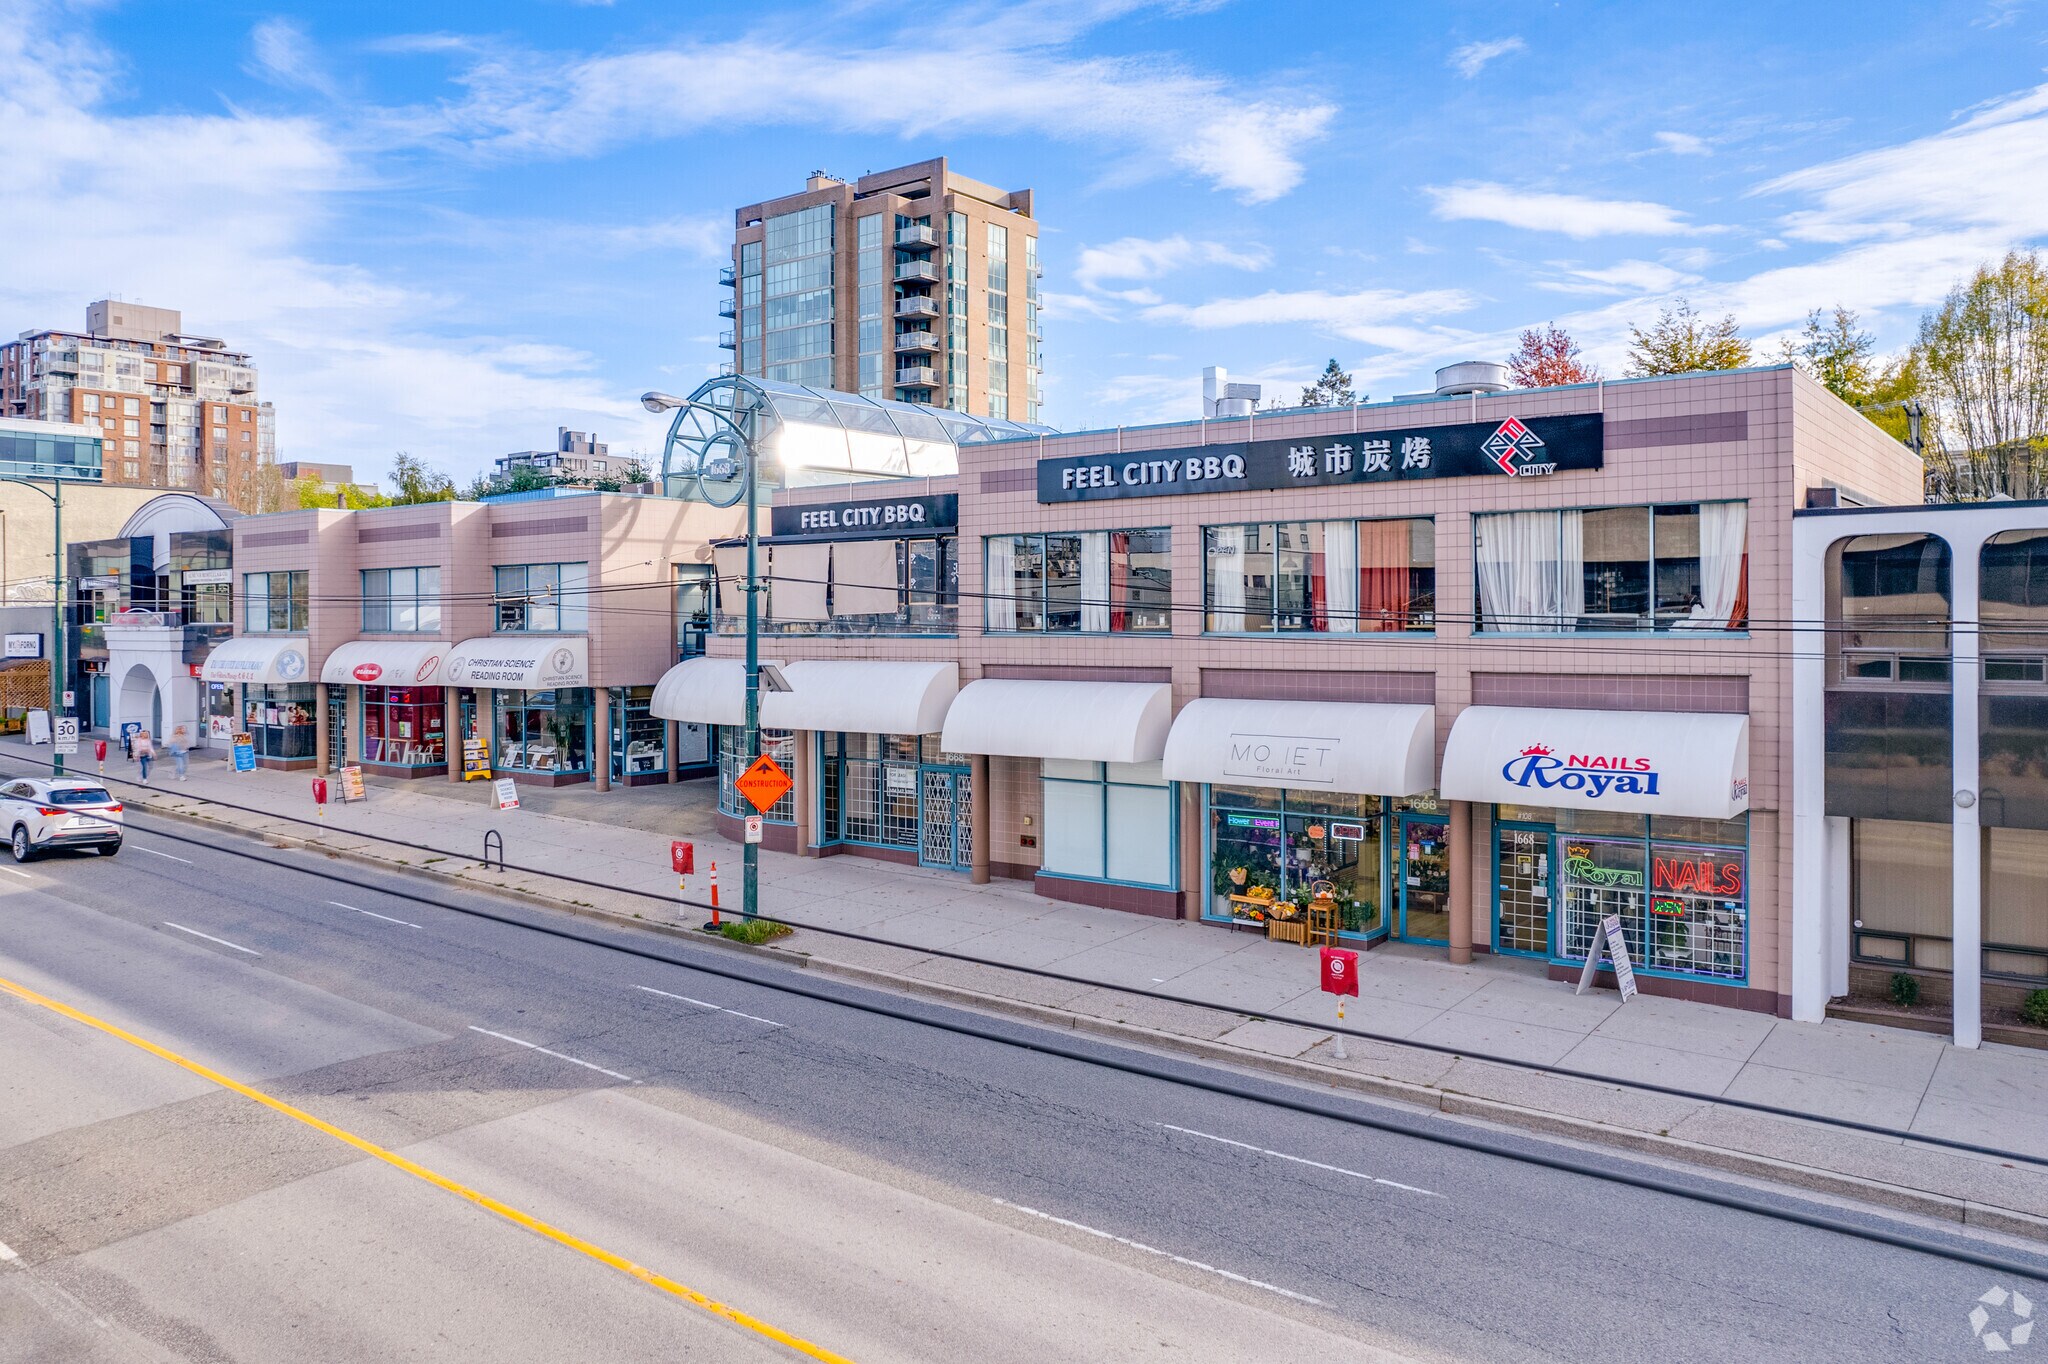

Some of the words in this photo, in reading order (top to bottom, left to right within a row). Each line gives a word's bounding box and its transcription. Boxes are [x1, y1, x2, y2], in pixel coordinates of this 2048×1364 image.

[1287, 436, 1432, 478] 城市炭烤
[1062, 464, 1118, 490] FEEL
[1122, 459, 1181, 486] CITY
[1185, 454, 1246, 480] BBQ
[1519, 462, 1558, 477] CITY
[801, 509, 840, 529] FEEL
[842, 506, 882, 527] CITY
[884, 503, 926, 523] BBQ
[467, 658, 505, 668] CHRISTIAN
[504, 659, 536, 669] SCIENCE
[470, 670, 501, 681] READING
[501, 671, 524, 682] ROOM
[57, 724, 76, 736] 30
[1256, 765, 1284, 774] Floral
[1287, 767, 1301, 775] Art
[1567, 754, 1651, 772] NAILS
[1502, 755, 1660, 798] Royal
[739, 780, 788, 788] CONSTRUCTION
[1409, 798, 1437, 810] 1668
[1333, 825, 1360, 839] OPEN
[1514, 833, 1535, 845] 1668
[1563, 857, 1644, 887] Royal
[1653, 857, 1741, 895] NAILS
